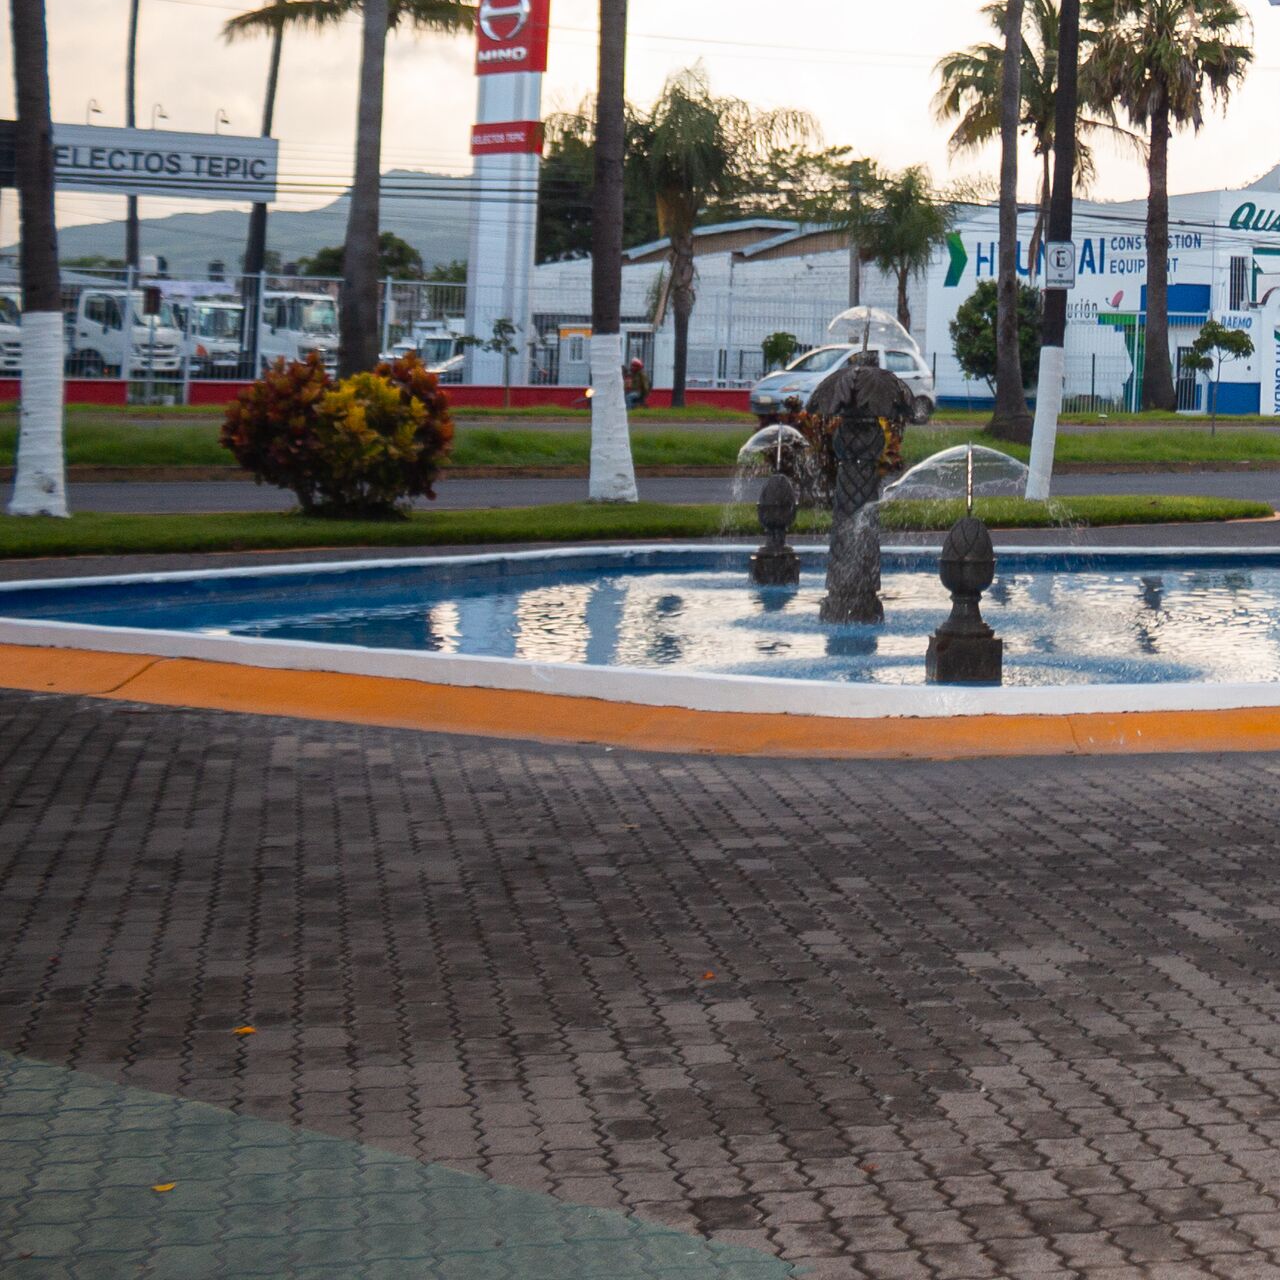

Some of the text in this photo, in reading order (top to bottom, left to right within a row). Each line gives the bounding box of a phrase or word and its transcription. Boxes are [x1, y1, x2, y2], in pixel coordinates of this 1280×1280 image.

[478, 46, 527, 62] HINO
[54, 145, 267, 180] ELECTOS TEPIC
[1111, 233, 1201, 251] CONSTION
[976, 238, 1105, 276] HUAI
[1110, 257, 1179, 275] EQUIPT
